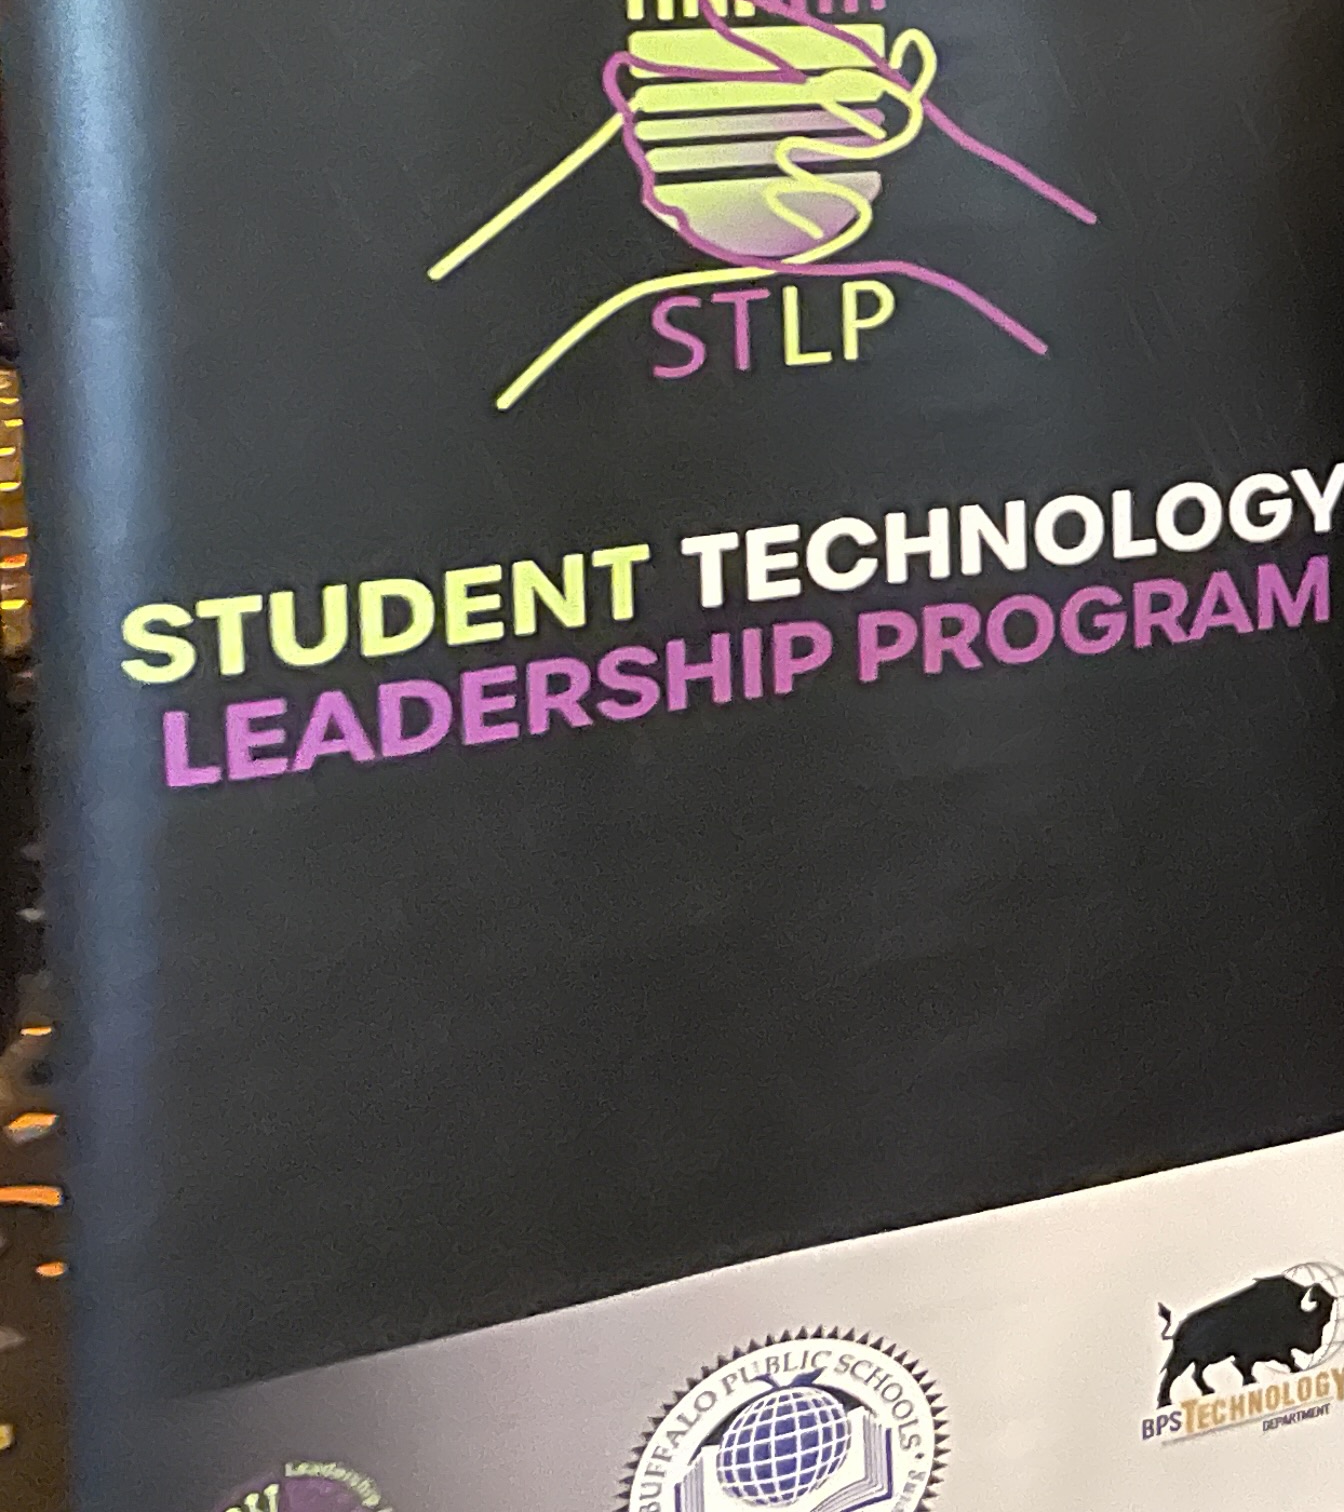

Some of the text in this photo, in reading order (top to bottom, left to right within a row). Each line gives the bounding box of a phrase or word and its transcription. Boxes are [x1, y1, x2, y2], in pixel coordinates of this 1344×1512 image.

[652, 280, 896, 379] STLP
[120, 543, 651, 685] STUDENT
[160, 554, 1334, 790] LEADERSHIP PROGRAM
[639, 1350, 922, 1512] BUFFALO PUBLIC SCHOOLS
[1262, 1402, 1332, 1433] DEPARTMENT
